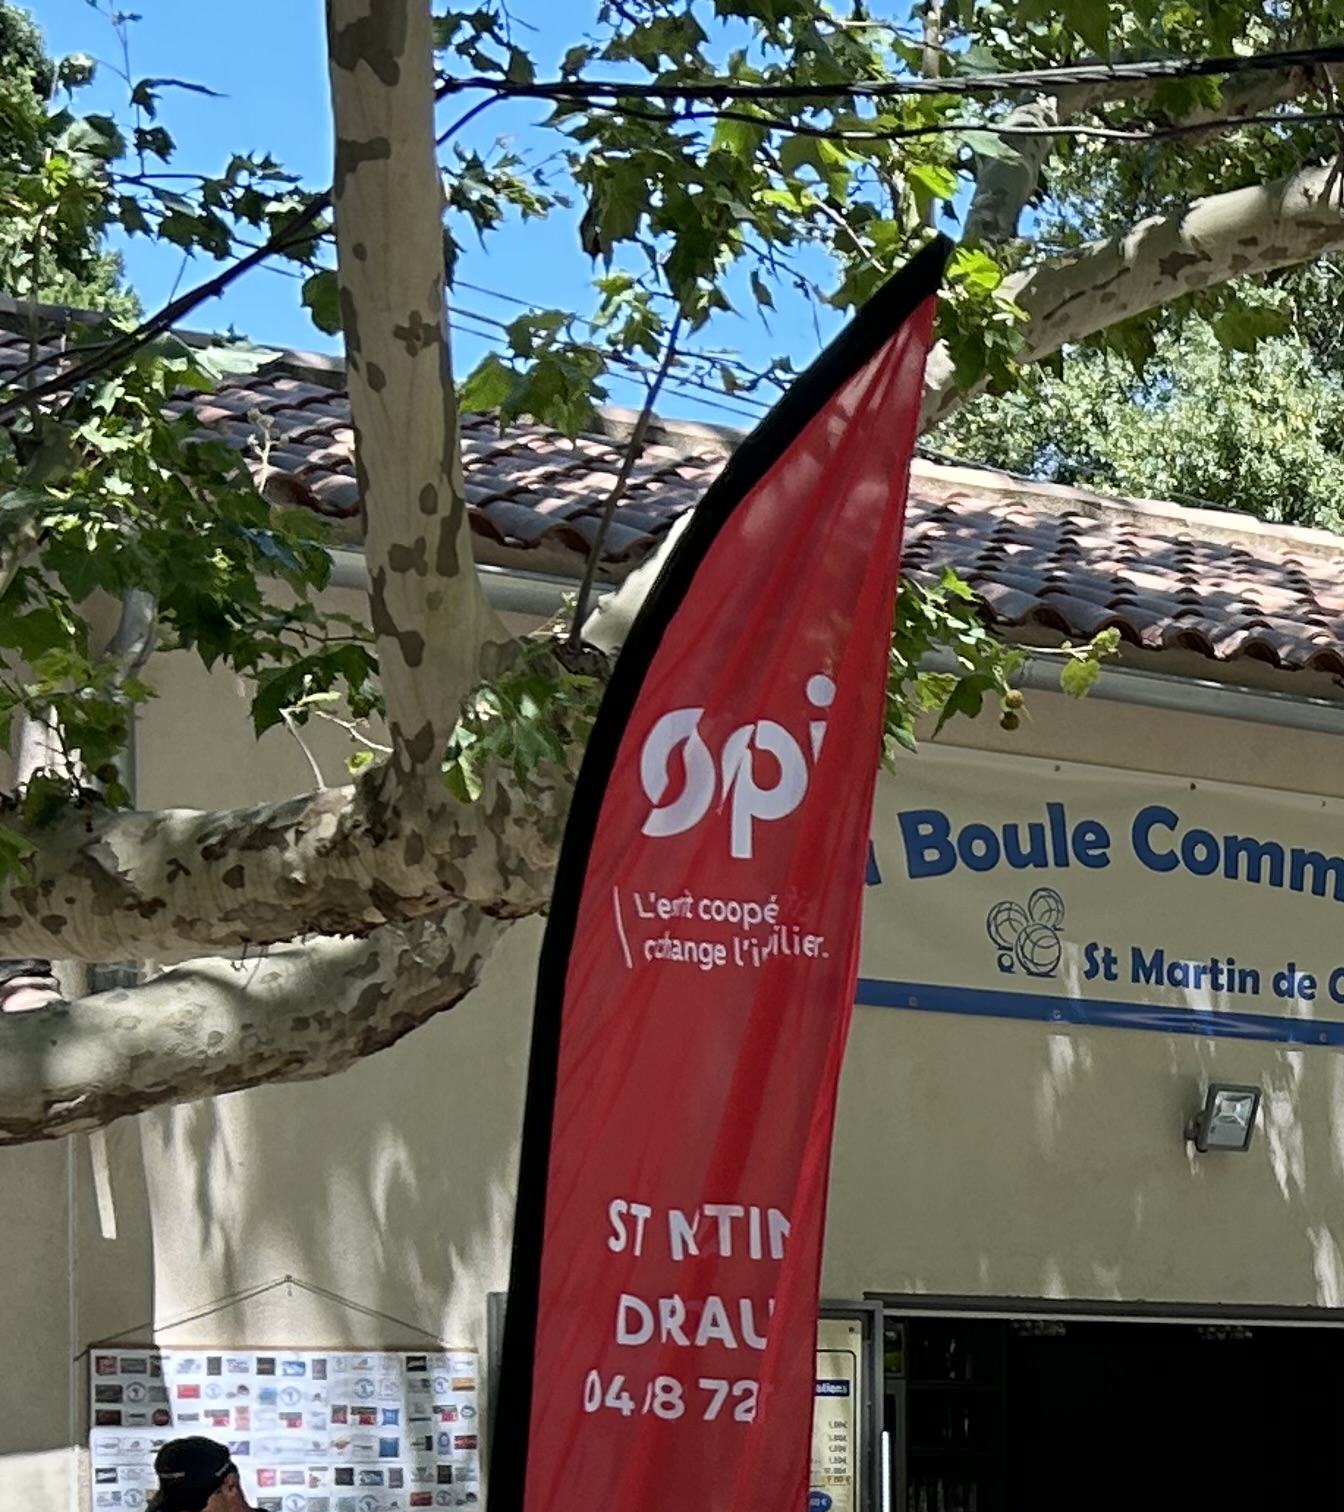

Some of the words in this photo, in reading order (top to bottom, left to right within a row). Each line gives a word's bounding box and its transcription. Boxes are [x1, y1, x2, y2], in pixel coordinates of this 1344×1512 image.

[897, 801, 1111, 879] Boule
[1083, 942, 1119, 982] St
[1131, 947, 1262, 996] Martin
[1272, 962, 1317, 1003] de
